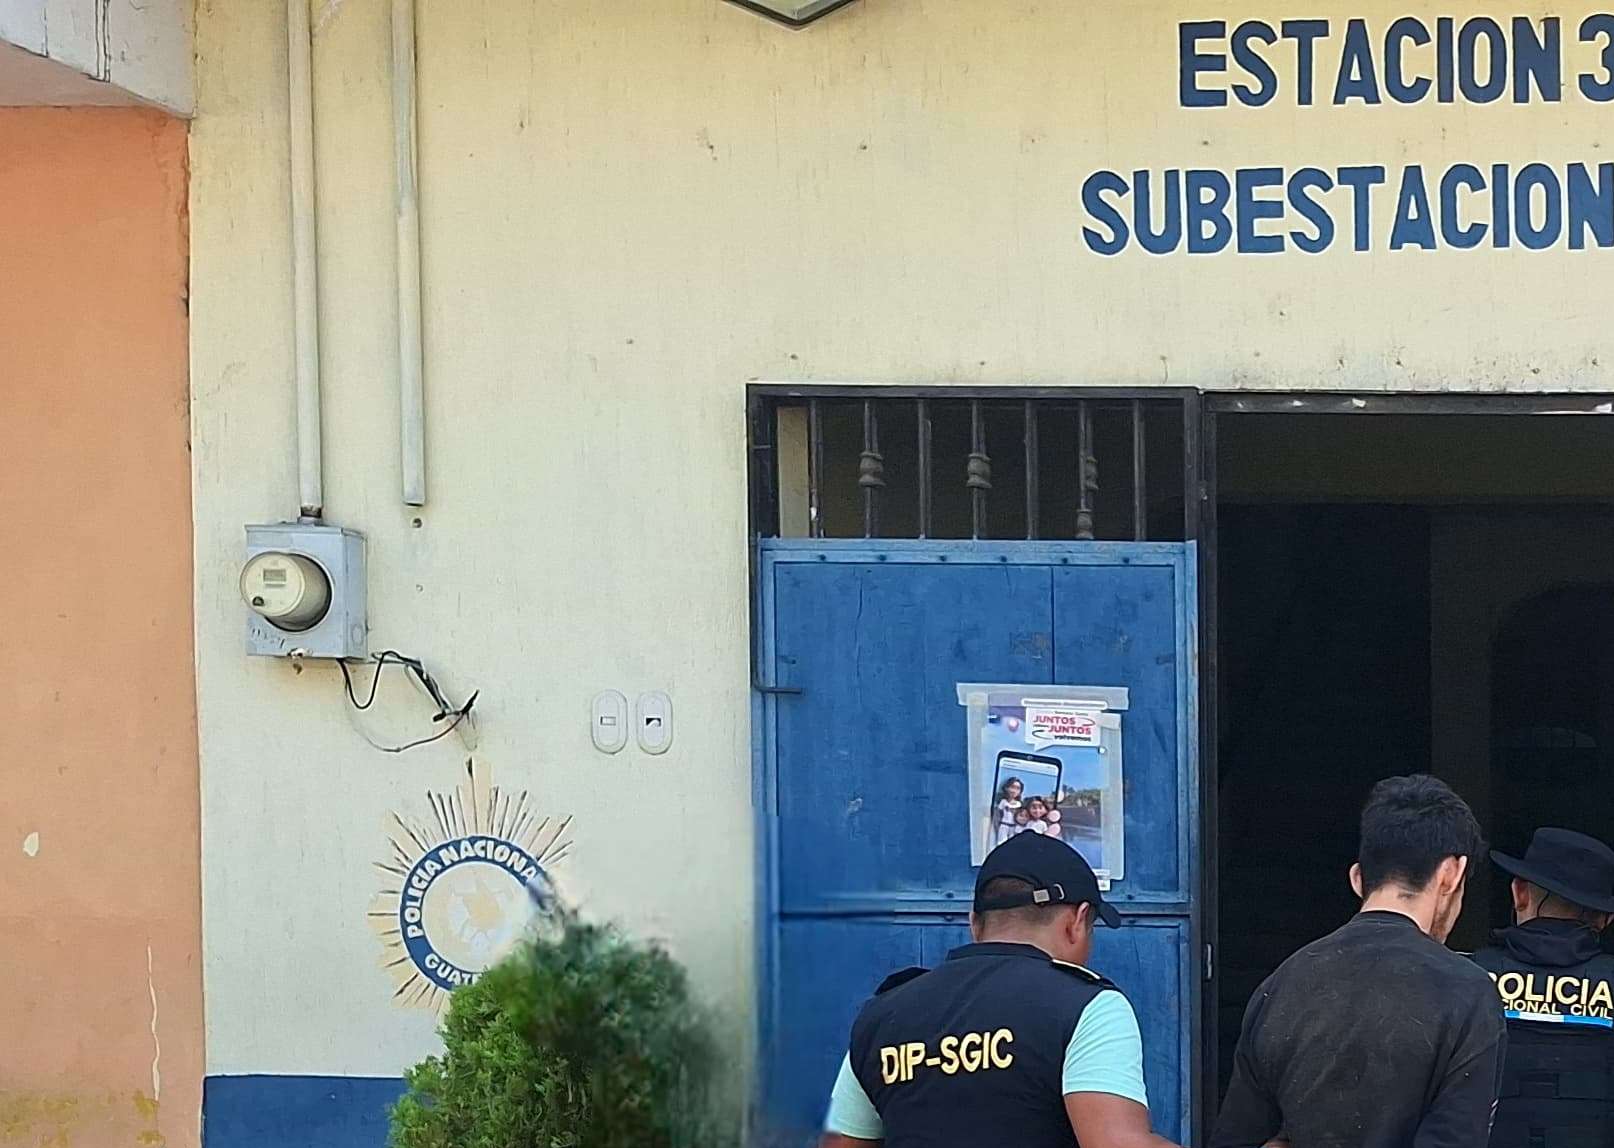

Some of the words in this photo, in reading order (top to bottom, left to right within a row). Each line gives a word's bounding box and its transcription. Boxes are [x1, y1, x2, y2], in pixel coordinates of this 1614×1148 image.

[1179, 17, 1562, 106] ESTACION
[1033, 715, 1076, 725] JUNTOS
[1048, 725, 1091, 735] JUNTOS
[404, 859, 442, 939] POLICIA
[438, 839, 538, 882] NACIONA
[1488, 972, 1613, 1009] OLICIA
[1570, 1004, 1613, 1020] CIVIL
[880, 1028, 1014, 1085] DIP-SGIC
